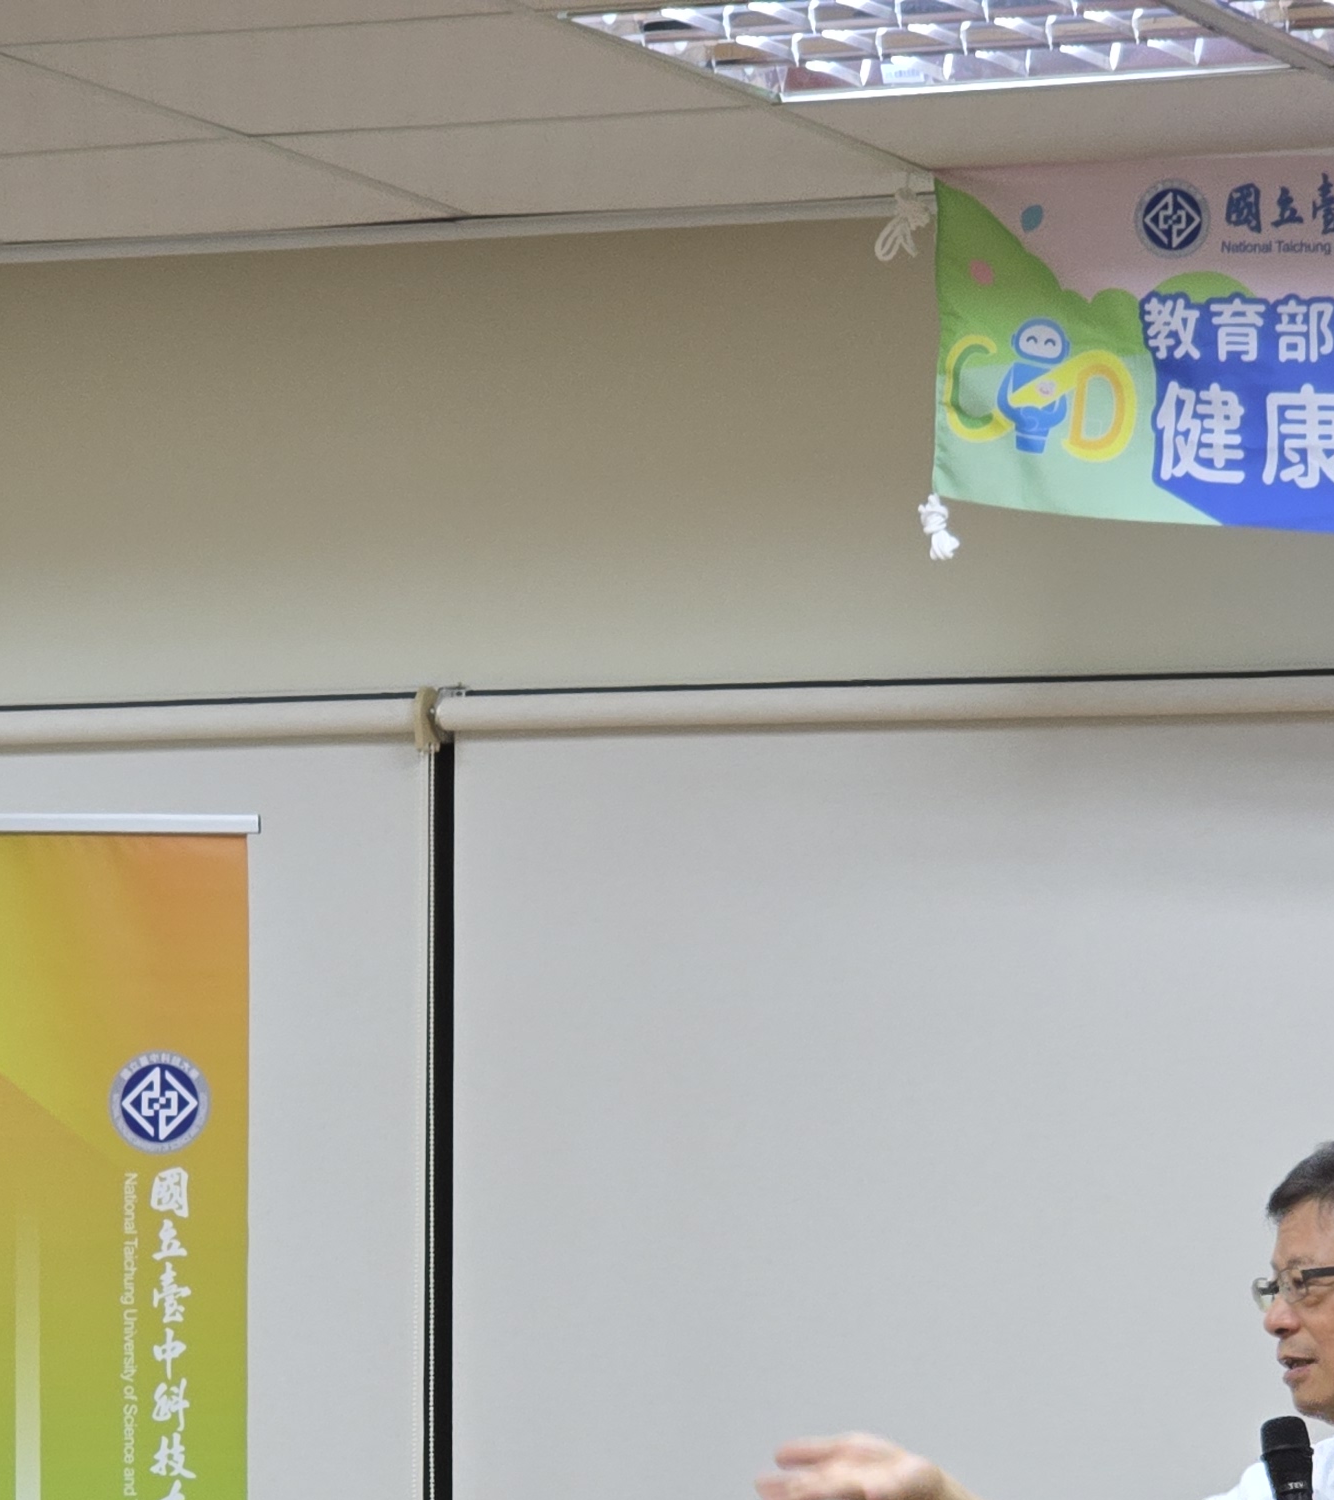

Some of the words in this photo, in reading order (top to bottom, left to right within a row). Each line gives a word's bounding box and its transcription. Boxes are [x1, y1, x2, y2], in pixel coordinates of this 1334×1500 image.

[1221, 240, 1271, 254] National
[1276, 239, 1331, 255] Taichung
[123, 1172, 138, 1234] National
[120, 1238, 138, 1305] Taichung
[120, 1309, 138, 1383] University
[123, 1385, 138, 1401] of
[123, 1404, 138, 1464] Science
[123, 1467, 138, 1496] and
